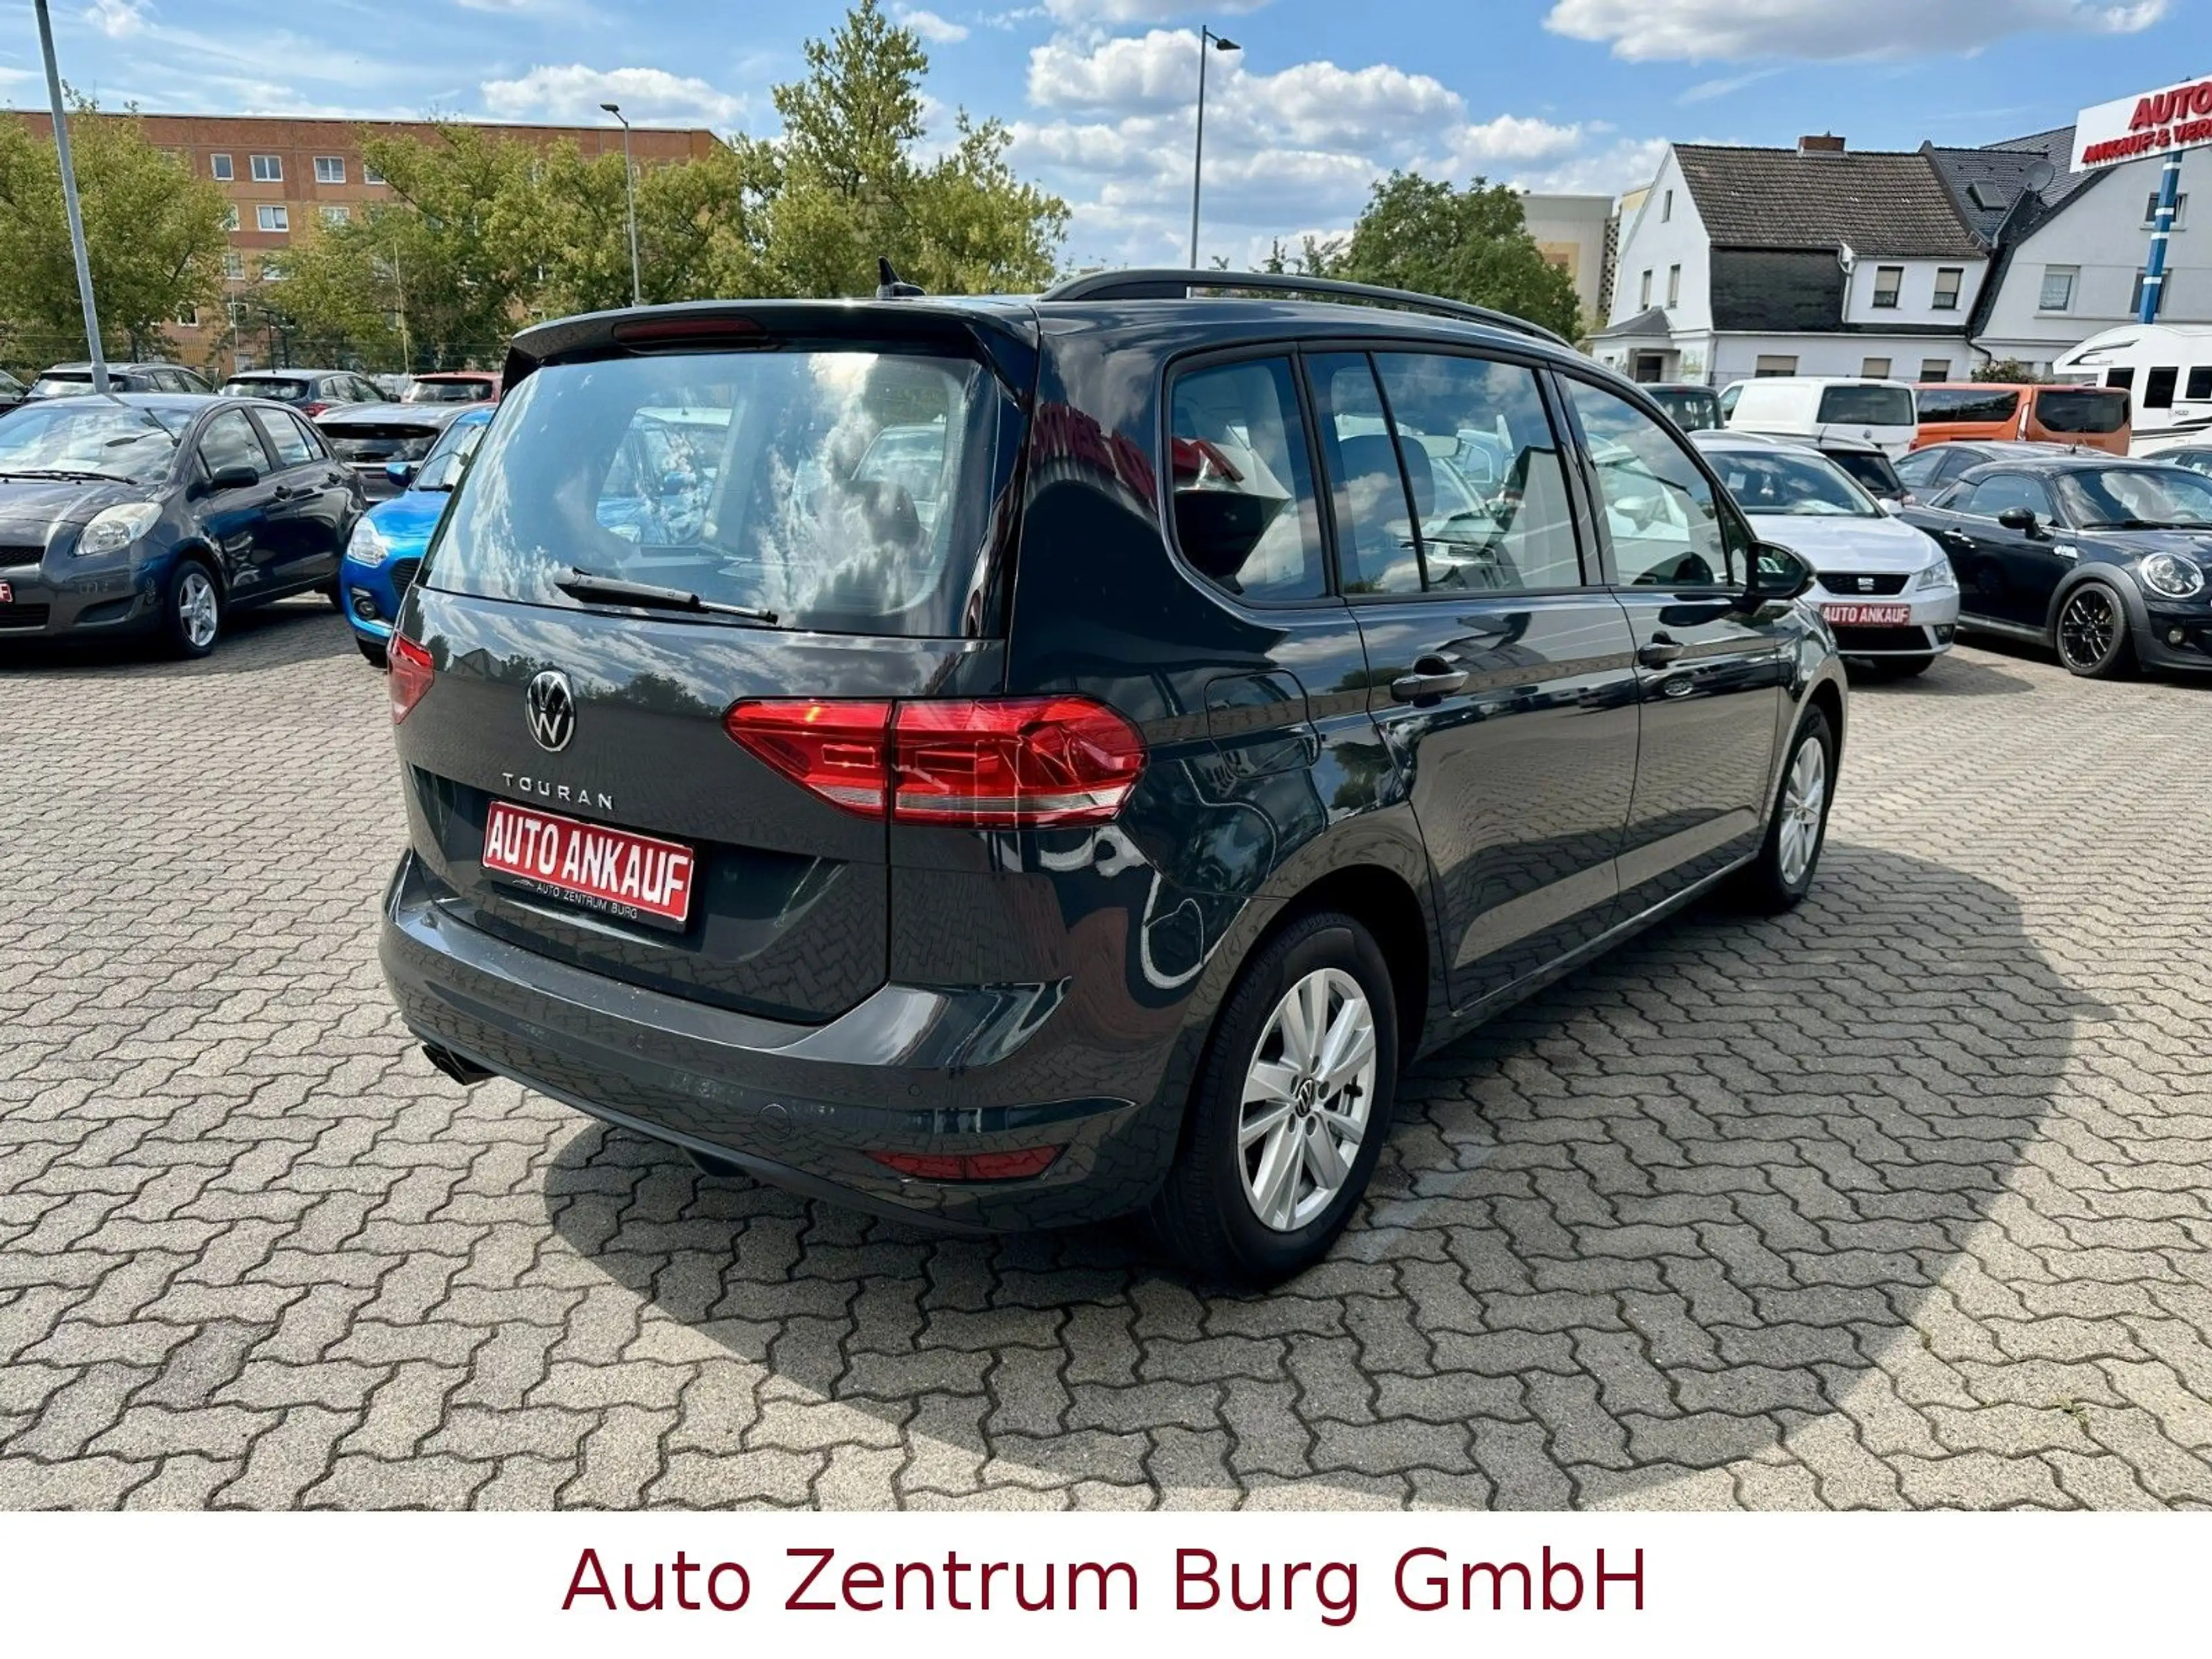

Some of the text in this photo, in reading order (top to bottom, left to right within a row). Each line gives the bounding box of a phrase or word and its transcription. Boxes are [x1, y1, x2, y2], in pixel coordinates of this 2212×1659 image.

[2128, 82, 2212, 131] AUTO
[2081, 118, 2212, 163] ANKAUF & VER
[1823, 607, 1910, 623] AUTO ANKAUF
[502, 772, 615, 810] TOURAN
[487, 811, 688, 907] AUTO ANKAUF
[536, 883, 638, 919] AUTO ZENTRUM BURG
